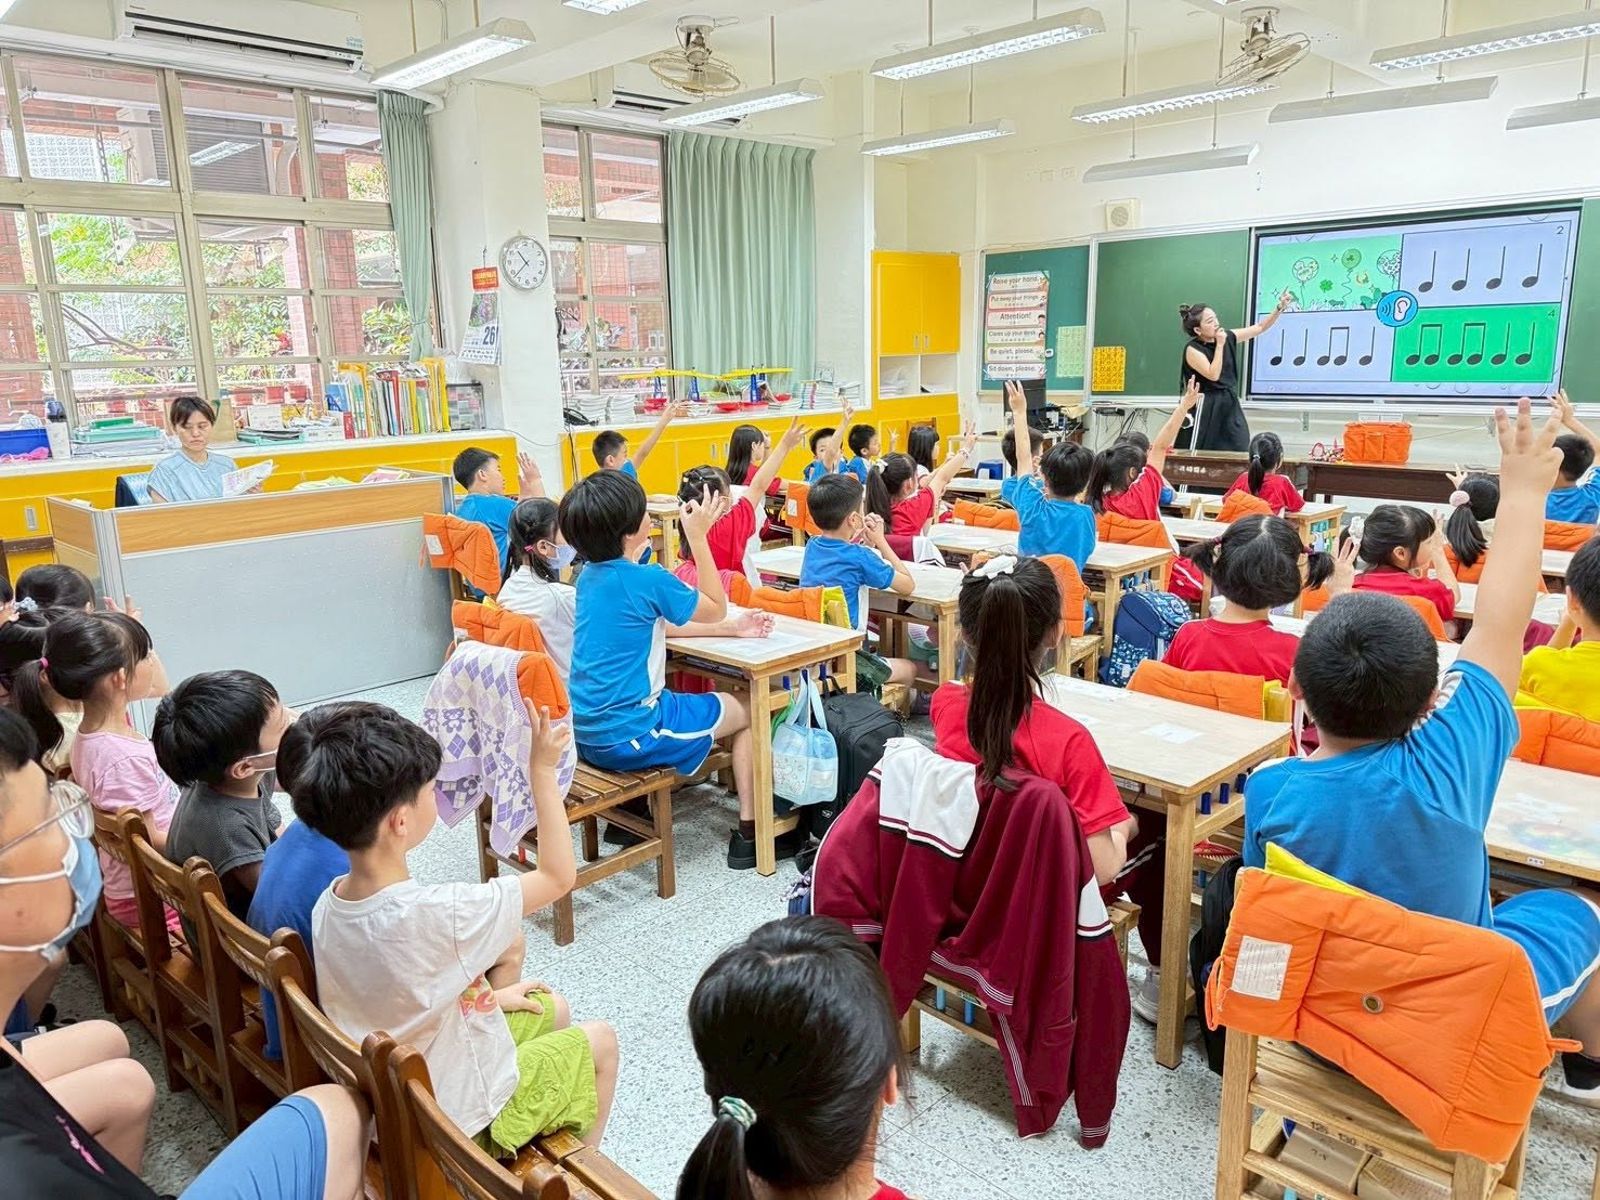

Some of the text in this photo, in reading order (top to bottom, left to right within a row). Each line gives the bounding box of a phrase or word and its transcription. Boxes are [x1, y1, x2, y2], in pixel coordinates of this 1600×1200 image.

[1556, 226, 1564, 235] 2
[1008, 278, 1021, 286] your
[1548, 309, 1555, 318] 4
[482, 326, 496, 345] 26
